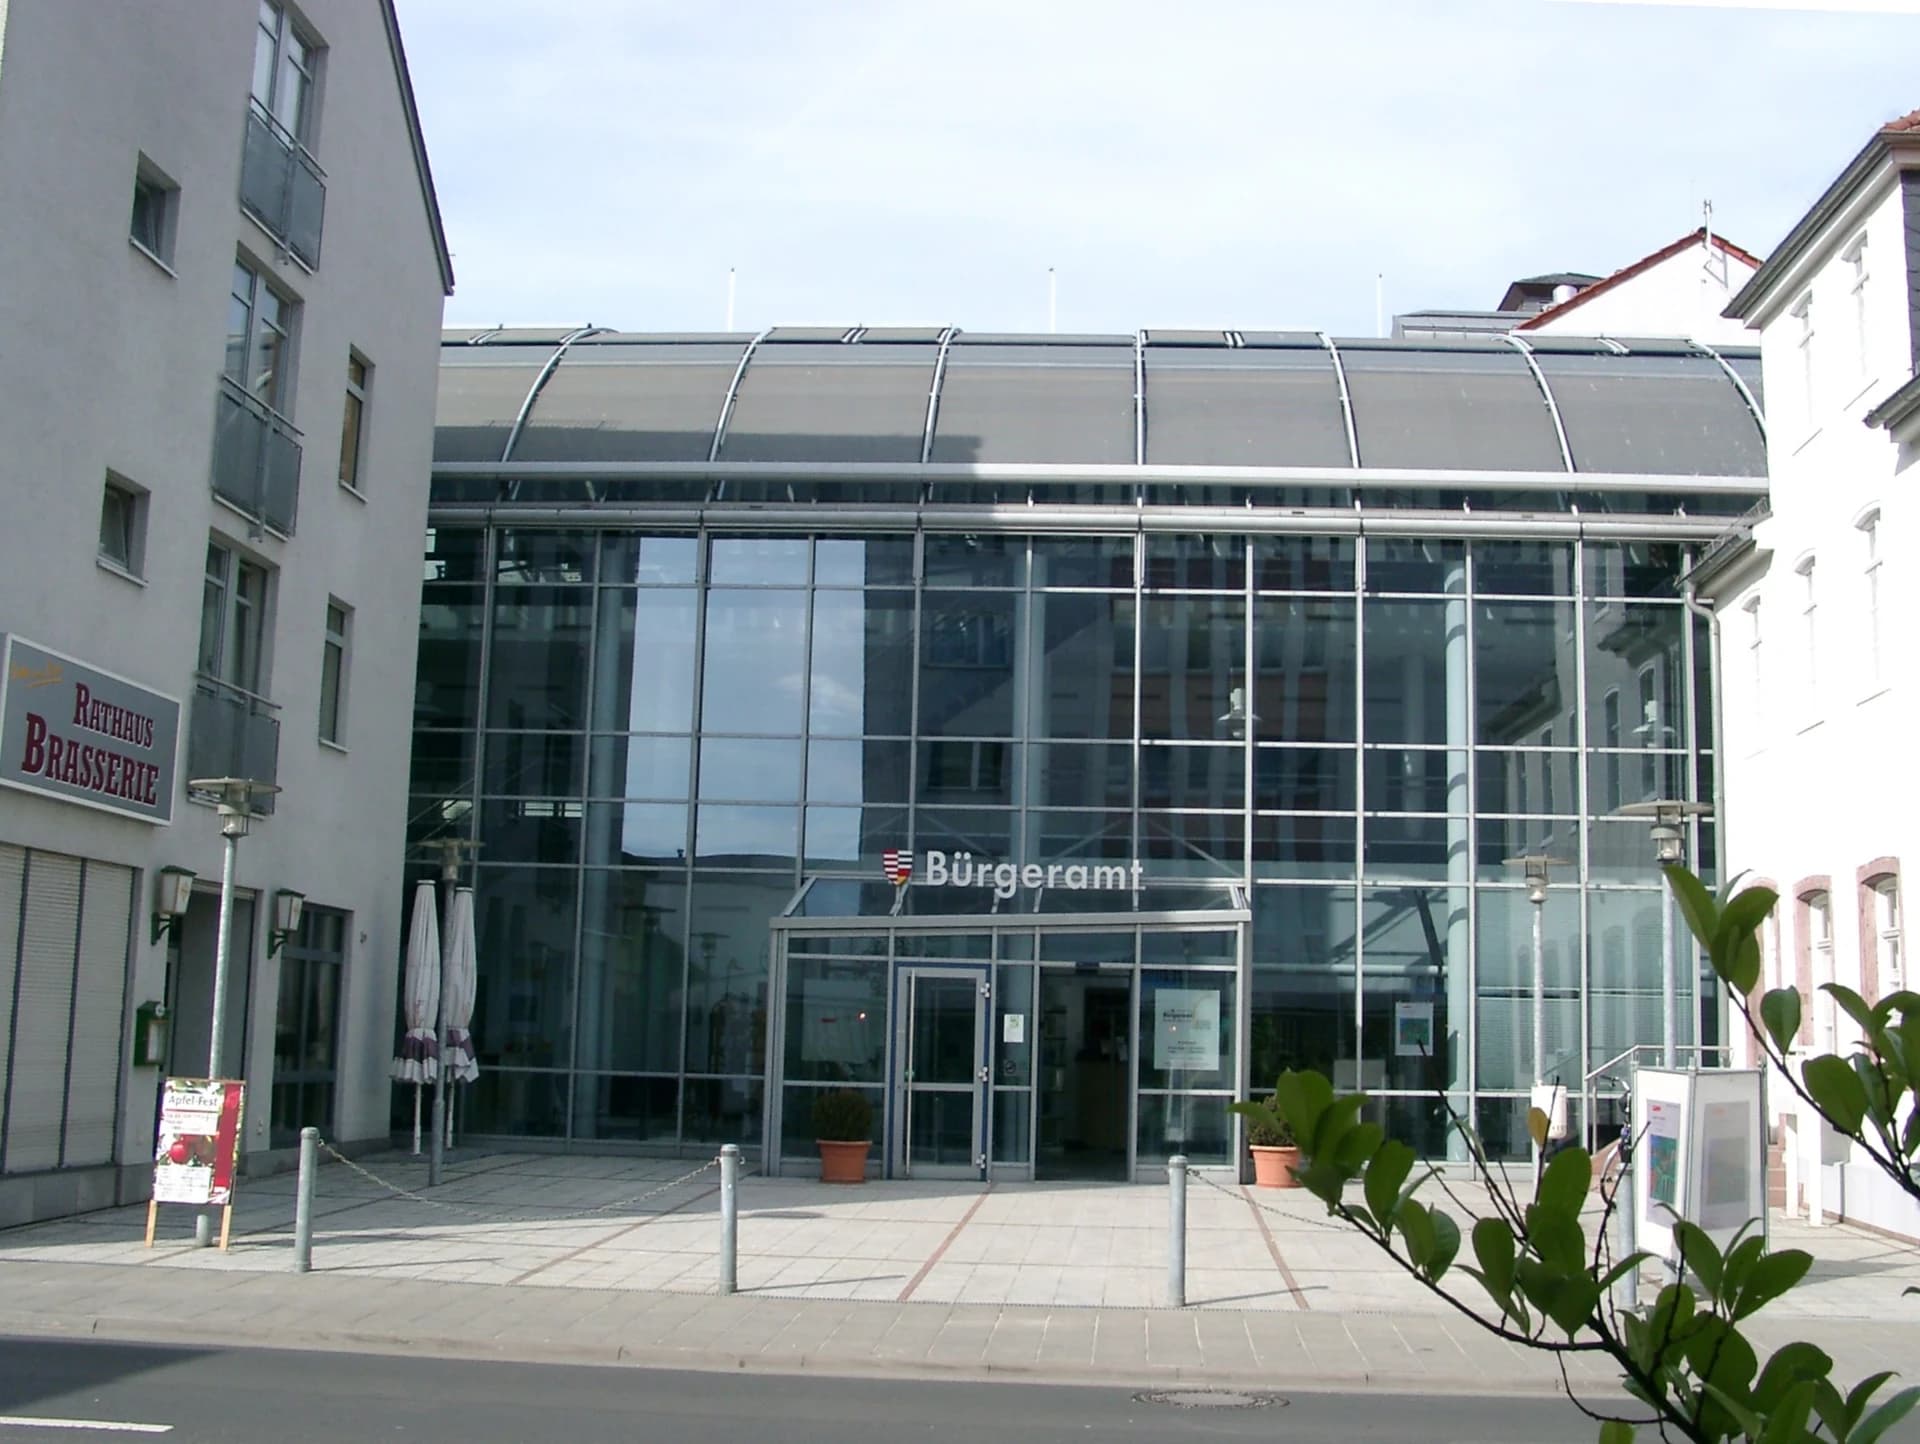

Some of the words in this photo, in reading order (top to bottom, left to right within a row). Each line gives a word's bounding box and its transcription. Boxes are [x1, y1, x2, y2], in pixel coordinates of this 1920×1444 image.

[73, 682, 154, 749] RATHAUS
[21, 712, 159, 806] BRASSERIE
[926, 850, 1146, 899] Bürgeramt
